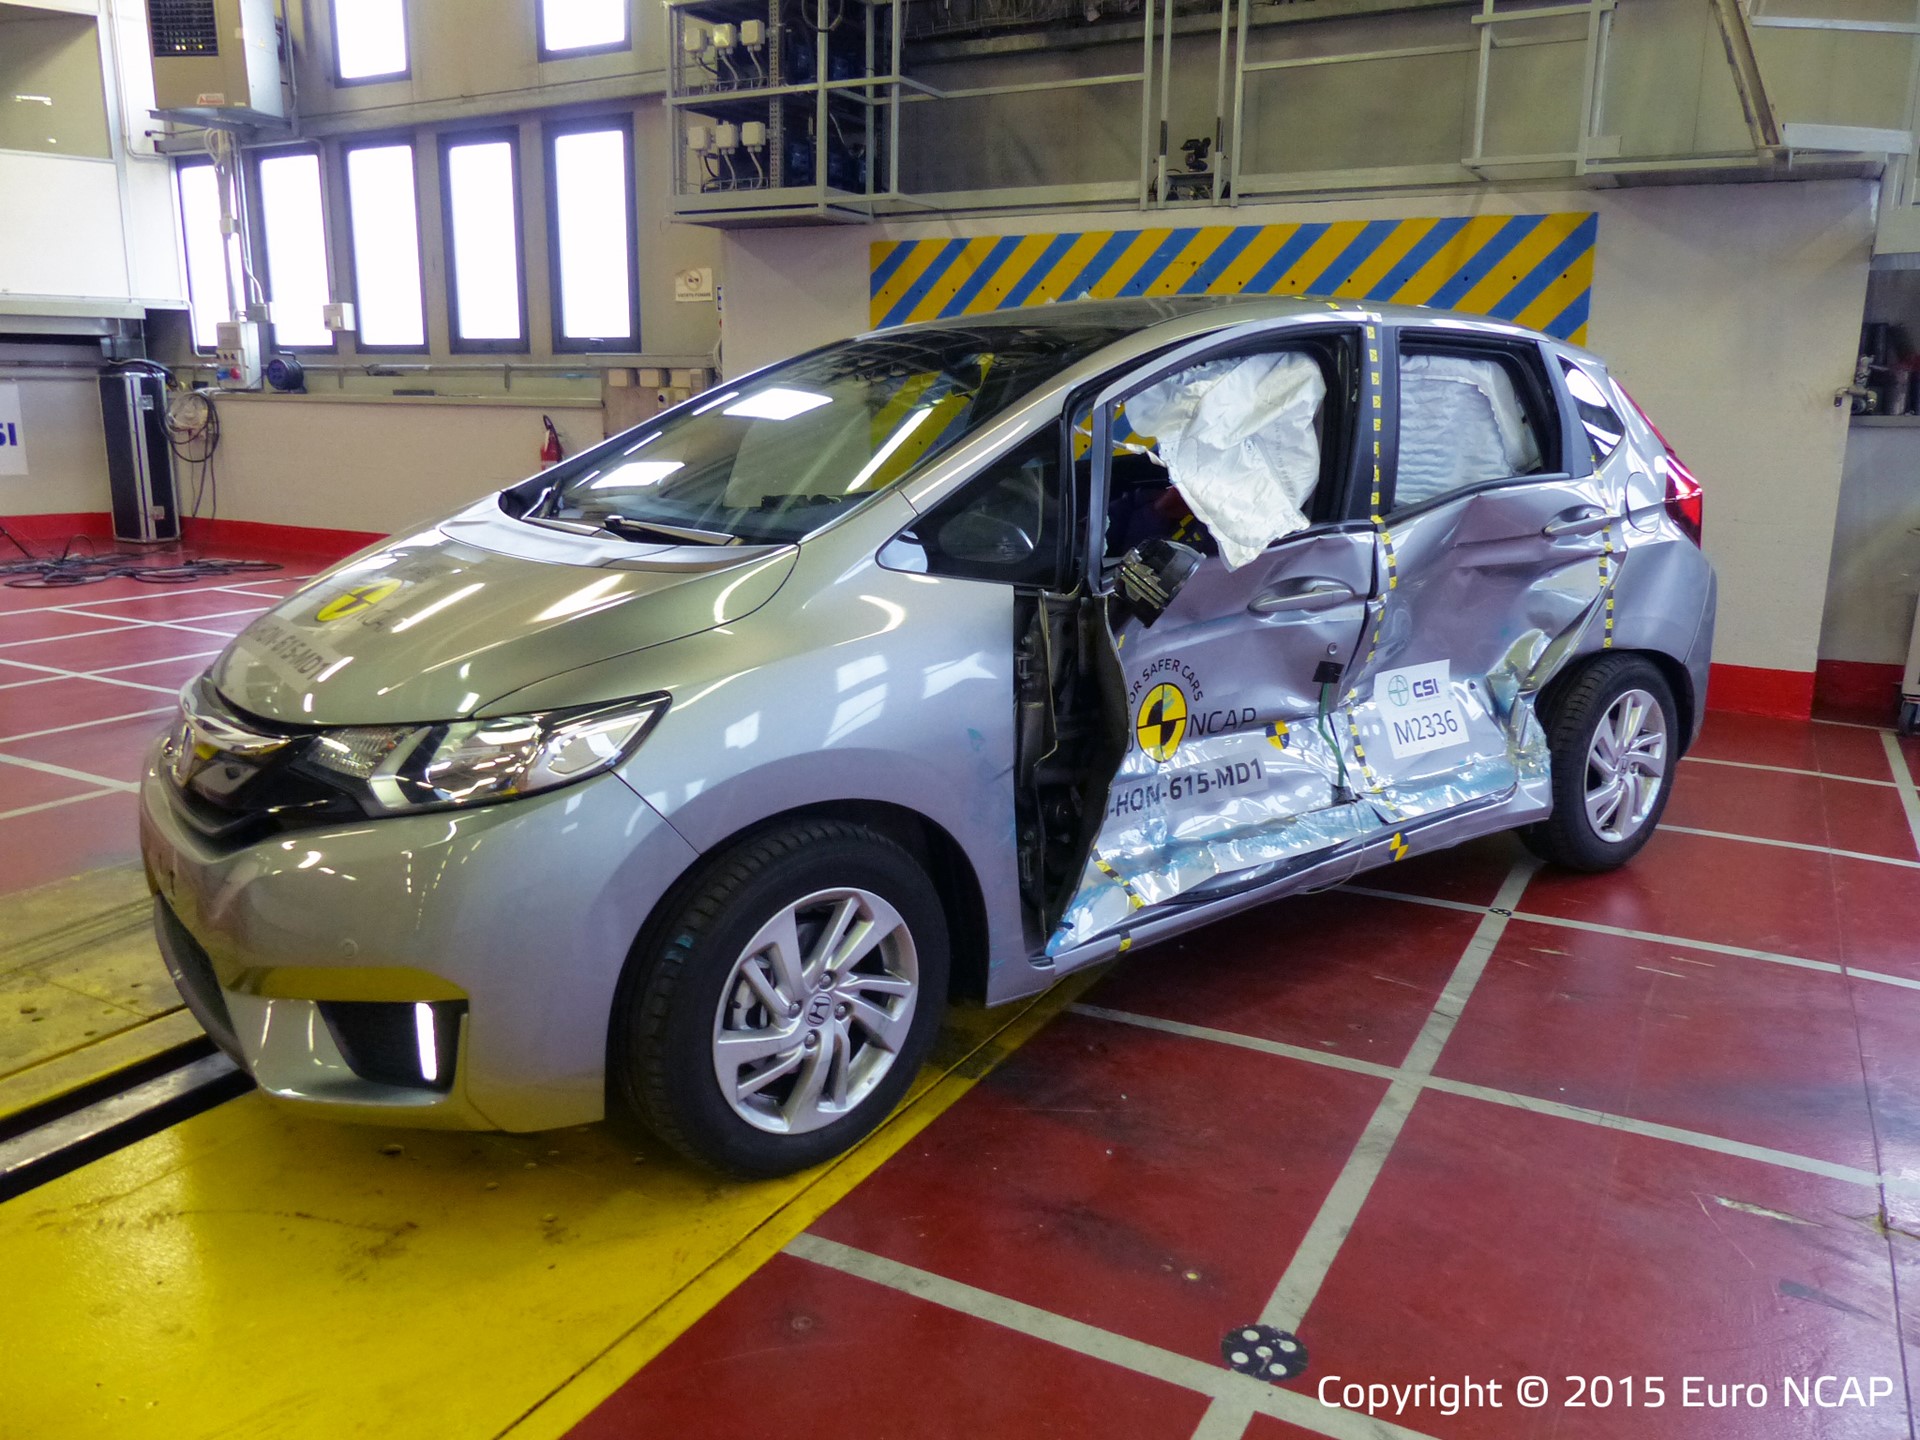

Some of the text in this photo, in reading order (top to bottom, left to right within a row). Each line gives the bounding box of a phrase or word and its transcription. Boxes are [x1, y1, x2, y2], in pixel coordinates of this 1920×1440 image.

[1129, 658, 1204, 704] OR SAFER CARS
[1412, 678, 1440, 698] CSI
[1189, 707, 1257, 738] NCAP
[1393, 710, 1458, 745] M2336
